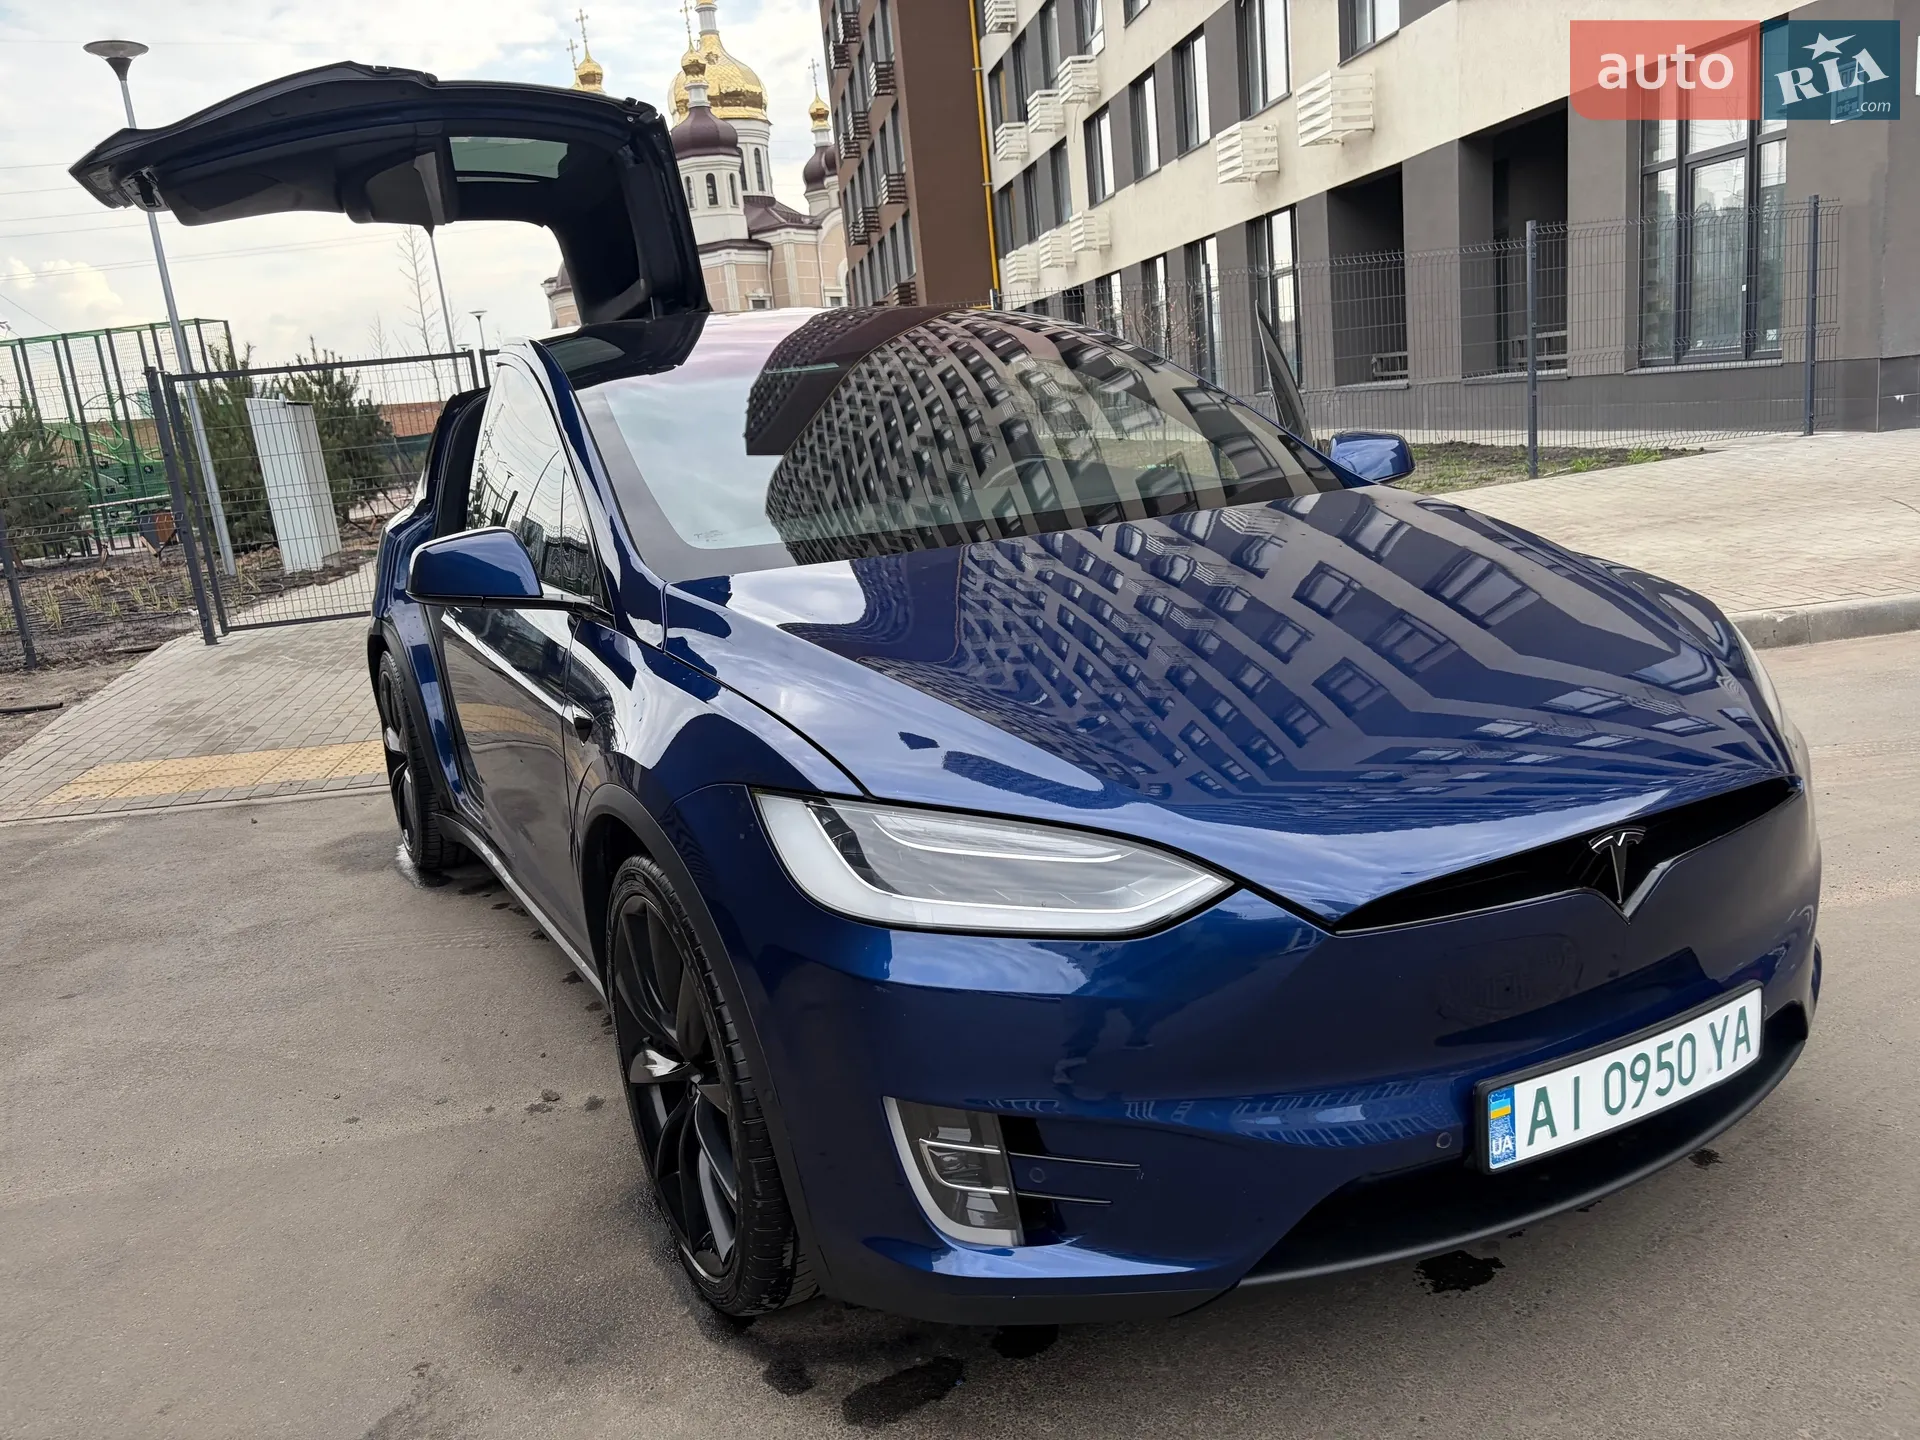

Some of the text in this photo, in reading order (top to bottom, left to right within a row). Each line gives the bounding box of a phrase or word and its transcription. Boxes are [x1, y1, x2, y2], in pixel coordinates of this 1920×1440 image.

[1527, 1005, 1751, 1147] AI 0950 YA
[1492, 1135, 1514, 1155] UA
